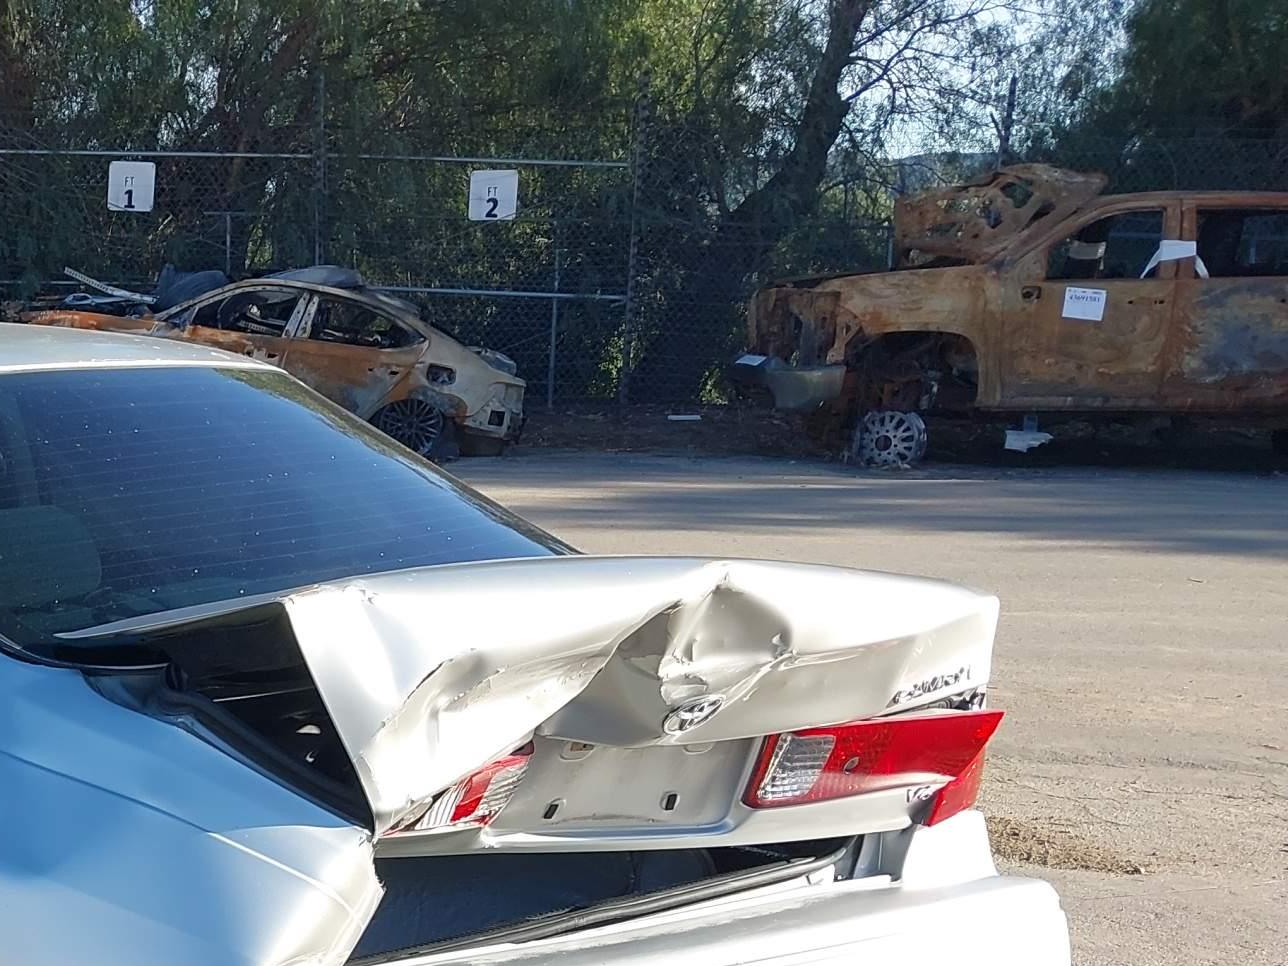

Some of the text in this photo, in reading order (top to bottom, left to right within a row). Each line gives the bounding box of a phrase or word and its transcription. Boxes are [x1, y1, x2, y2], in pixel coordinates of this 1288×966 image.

[124, 176, 135, 187] FT
[124, 189, 136, 209] 1
[487, 186, 498, 197] FT
[485, 197, 499, 218] 2
